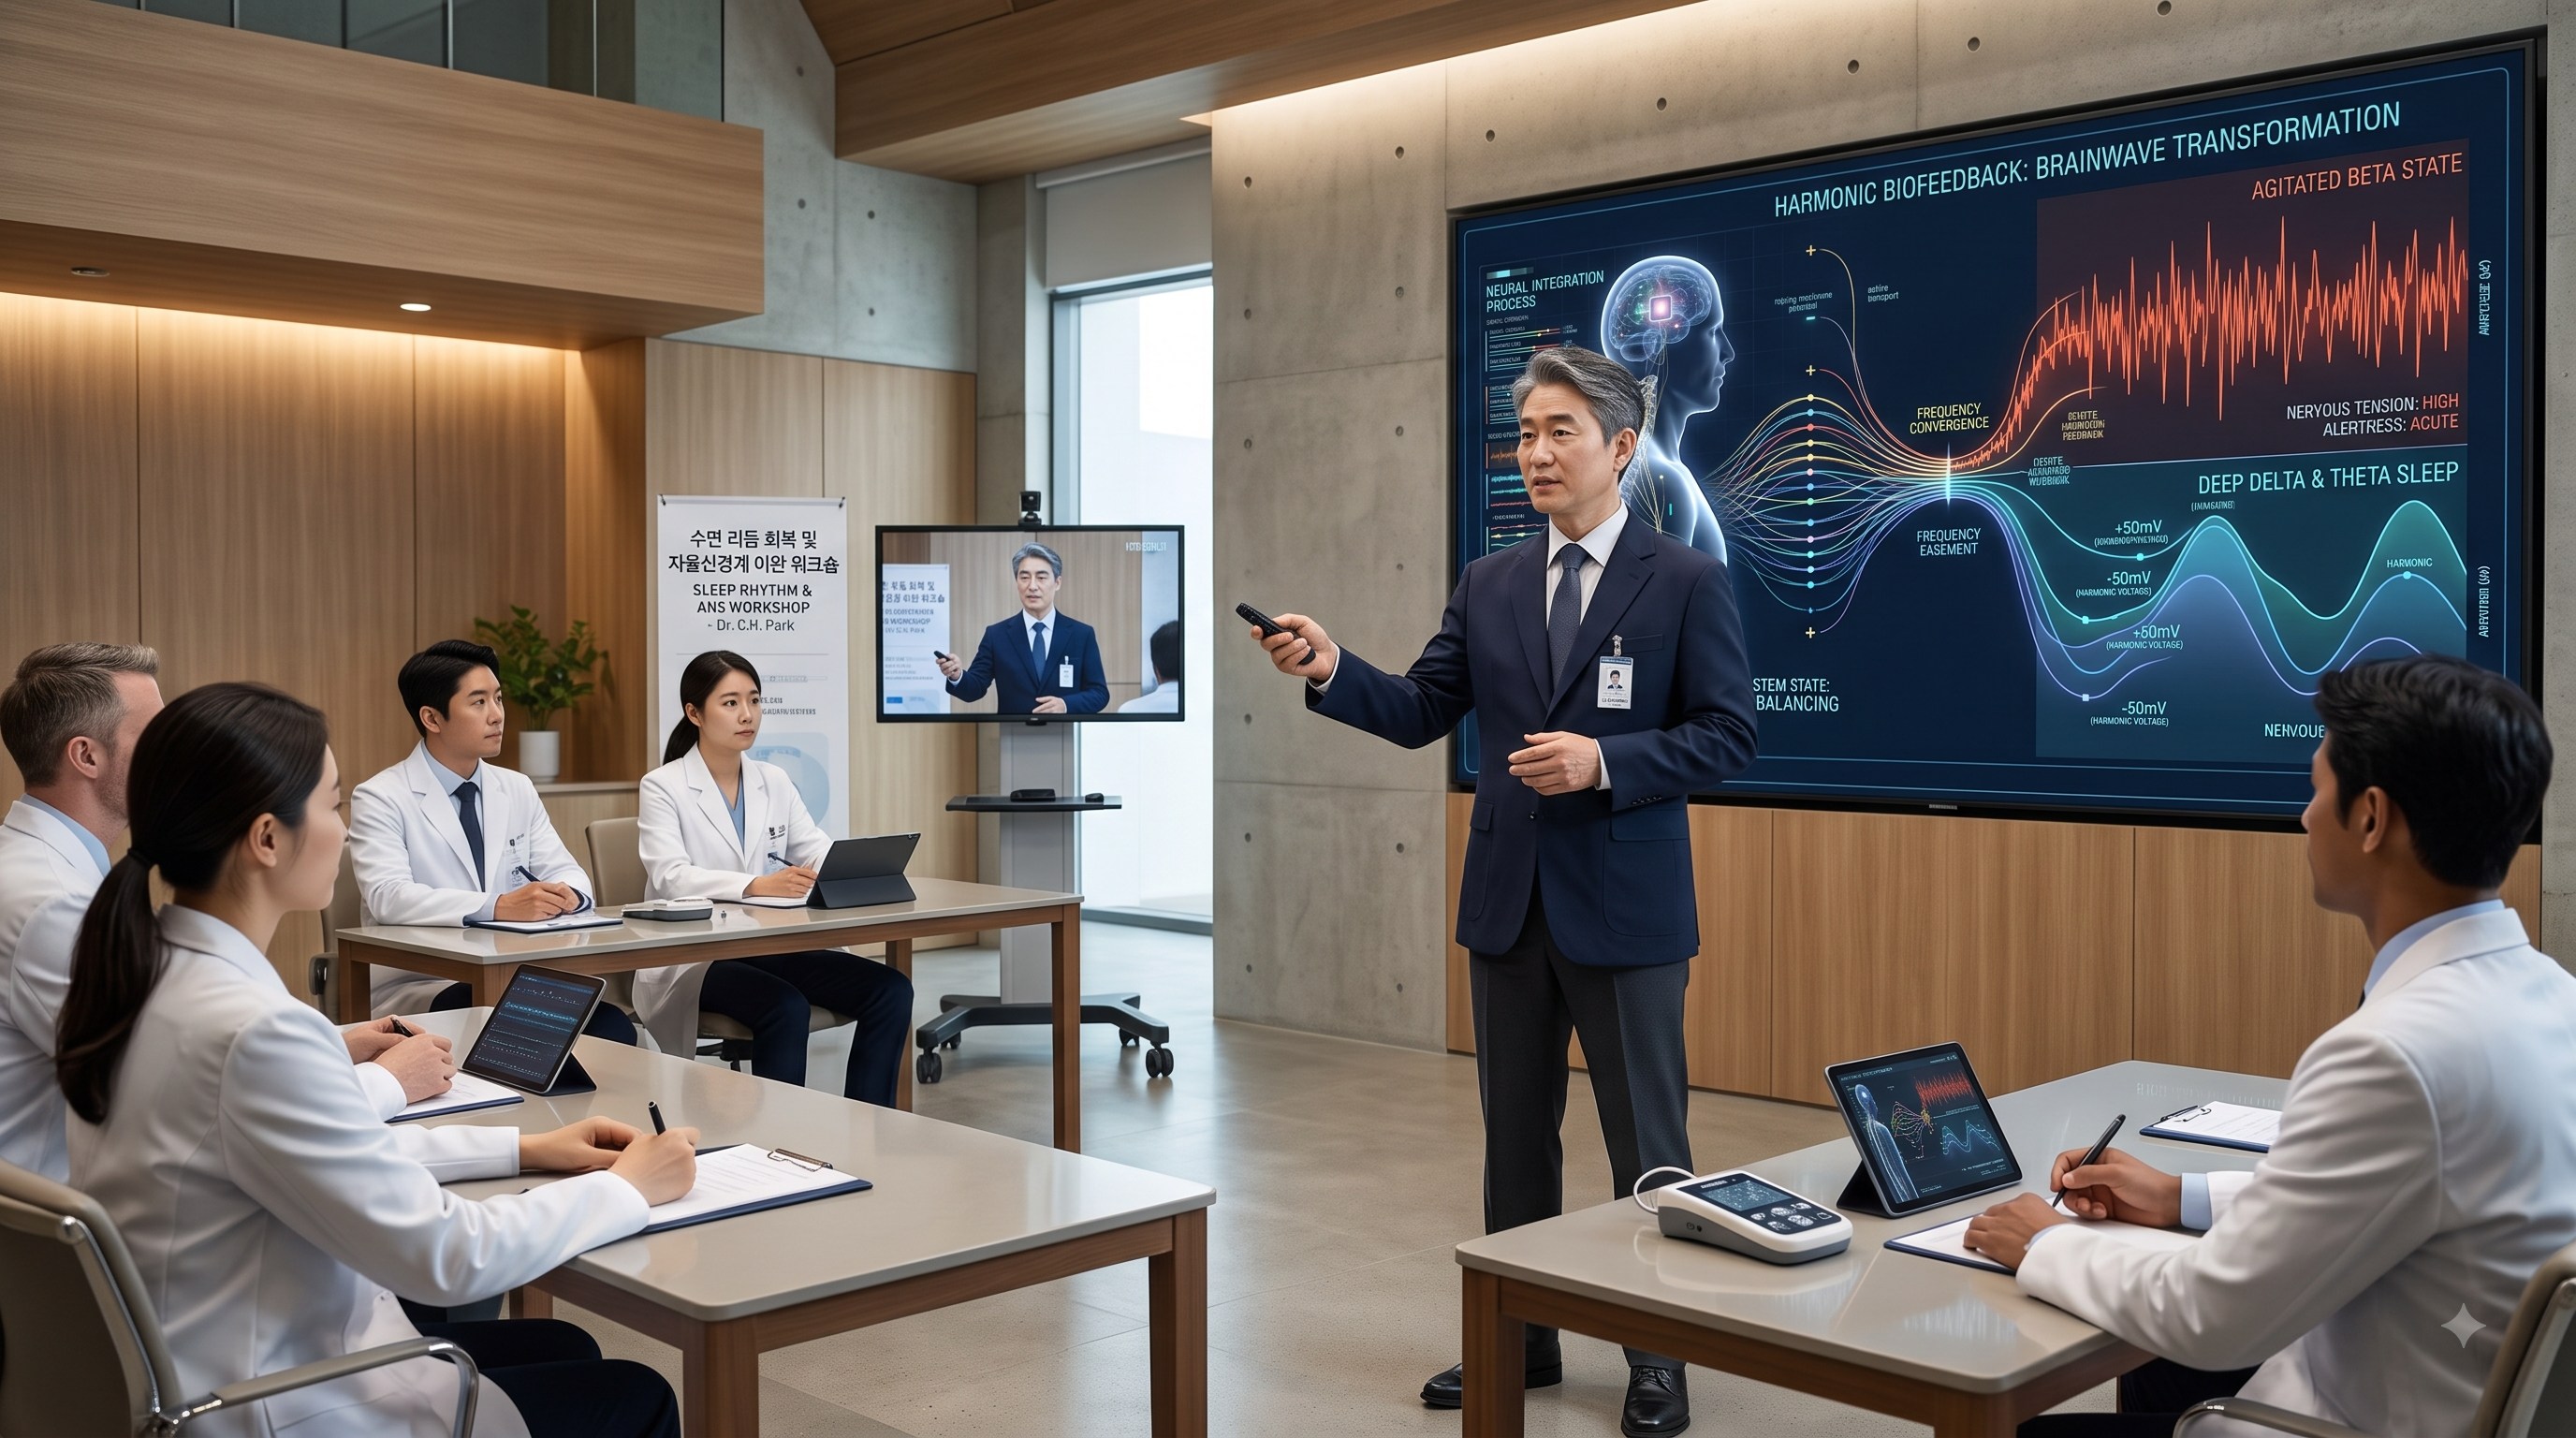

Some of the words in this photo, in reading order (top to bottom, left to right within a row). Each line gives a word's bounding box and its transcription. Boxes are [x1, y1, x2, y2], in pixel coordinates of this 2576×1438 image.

[1775, 182, 1878, 217] HARMONIC
[1882, 159, 2029, 202] BIOFEEDBACK:
[2036, 138, 2167, 181] BRAINWAVE
[2173, 101, 2401, 159] TRANSFORMATION
[2251, 170, 2341, 200] AGITATED
[2348, 163, 2396, 188] BETA
[2402, 152, 2464, 180] STATE
[1486, 281, 1529, 298] NEURAL
[1531, 270, 1604, 292] INTEGRATION
[1486, 295, 1536, 313] PROCESS
[1916, 403, 1982, 420] FREQUENCY
[2353, 396, 2420, 416] TENSION:
[2422, 392, 2459, 410] HIGH
[1910, 417, 1990, 434] CONVERGENCE
[2410, 413, 2459, 432] ACUTE
[2198, 473, 2244, 494] DEEP
[2249, 470, 2305, 492] DELTA
[2311, 468, 2325, 489] &
[2330, 465, 2392, 488] THETA
[2396, 461, 2460, 484] SLEEP
[1916, 527, 1982, 543] FREQUENCY
[2115, 520, 2162, 535] +50mV
[690, 529, 722, 549] 수면
[727, 529, 760, 549] 리듬
[764, 530, 797, 549] 회복
[801, 530, 817, 549] 및
[1920, 542, 1979, 557] EASEMENT
[668, 554, 750, 574] 자율신경계
[754, 554, 787, 574] 이완
[2106, 570, 2152, 586] -50mV
[693, 583, 737, 596] SLEEP
[739, 583, 798, 597] RHYTHM
[801, 583, 812, 597] &
[696, 600, 726, 613] ANS
[729, 601, 811, 614] WORKSHOP
[716, 619, 735, 631] Dr.
[737, 619, 763, 631] C.H.
[766, 619, 795, 631] Park
[1752, 677, 1787, 692] STEM
[1790, 677, 1830, 693] STATE:
[2121, 700, 2167, 715] -50mV
